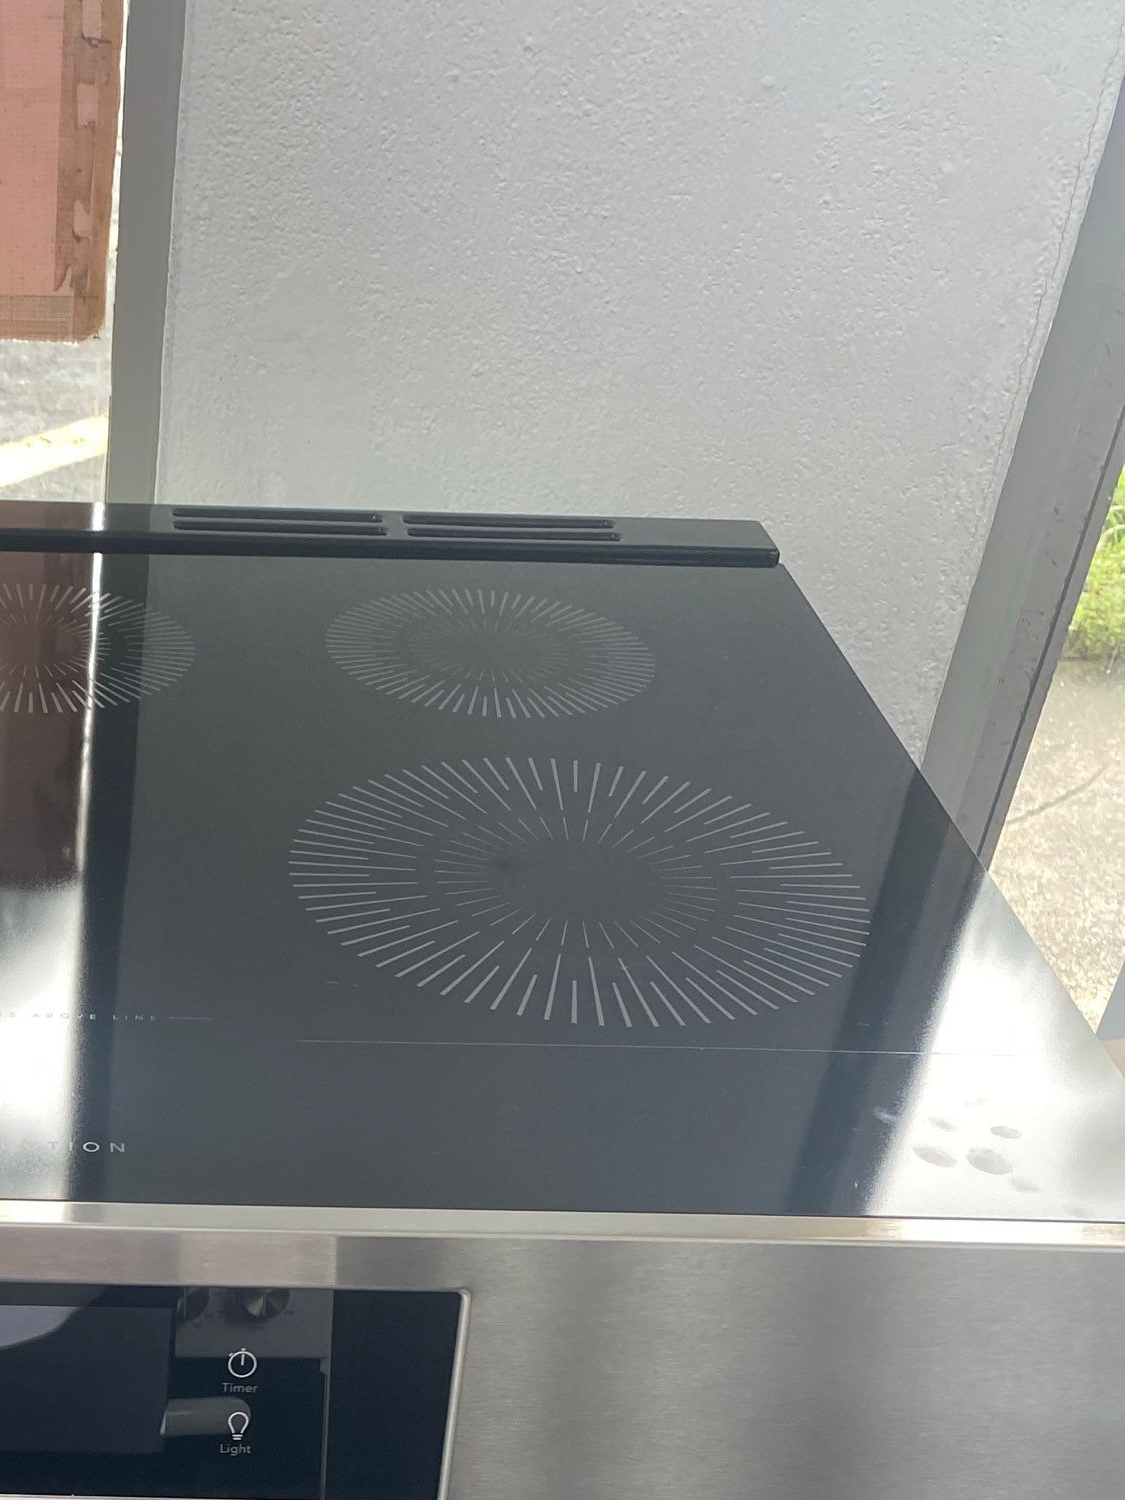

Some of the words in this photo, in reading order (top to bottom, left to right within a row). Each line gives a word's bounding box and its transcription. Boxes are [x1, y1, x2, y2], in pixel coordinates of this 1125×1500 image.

[112, 1014, 159, 1023] LINE
[221, 1382, 260, 1394] Timer
[219, 1443, 252, 1457] Light
